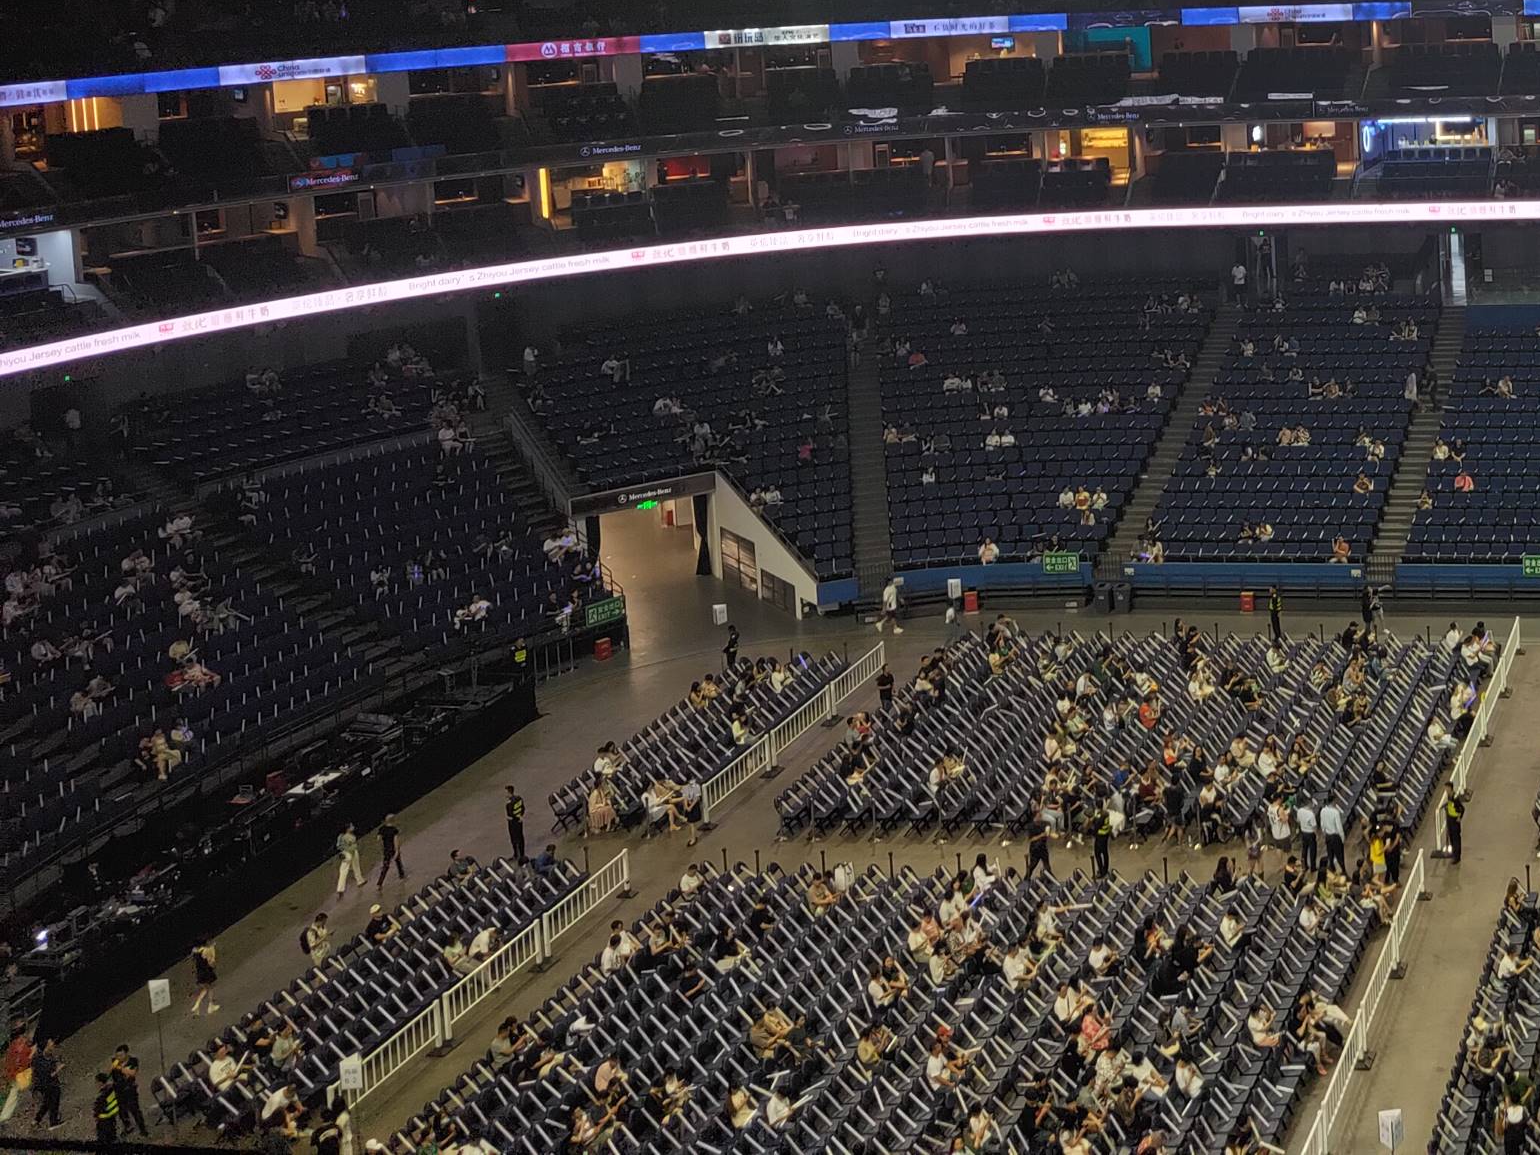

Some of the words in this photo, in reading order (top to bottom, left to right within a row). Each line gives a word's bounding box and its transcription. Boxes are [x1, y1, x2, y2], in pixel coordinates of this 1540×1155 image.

[277, 64, 300, 73] China
[592, 144, 641, 155] Mercedes-Benz
[305, 173, 359, 186] Mercedes-Benz
[408, 278, 437, 293] Bright
[477, 269, 508, 282] Zhiyou
[509, 264, 541, 278] Jersey
[542, 260, 567, 272] cattle
[592, 254, 611, 265] milk
[29, 345, 63, 362] Jersey
[65, 340, 91, 354] cattle
[94, 335, 120, 348] fresh
[121, 330, 142, 343] milk
[628, 486, 672, 501] Mercedes-Benz
